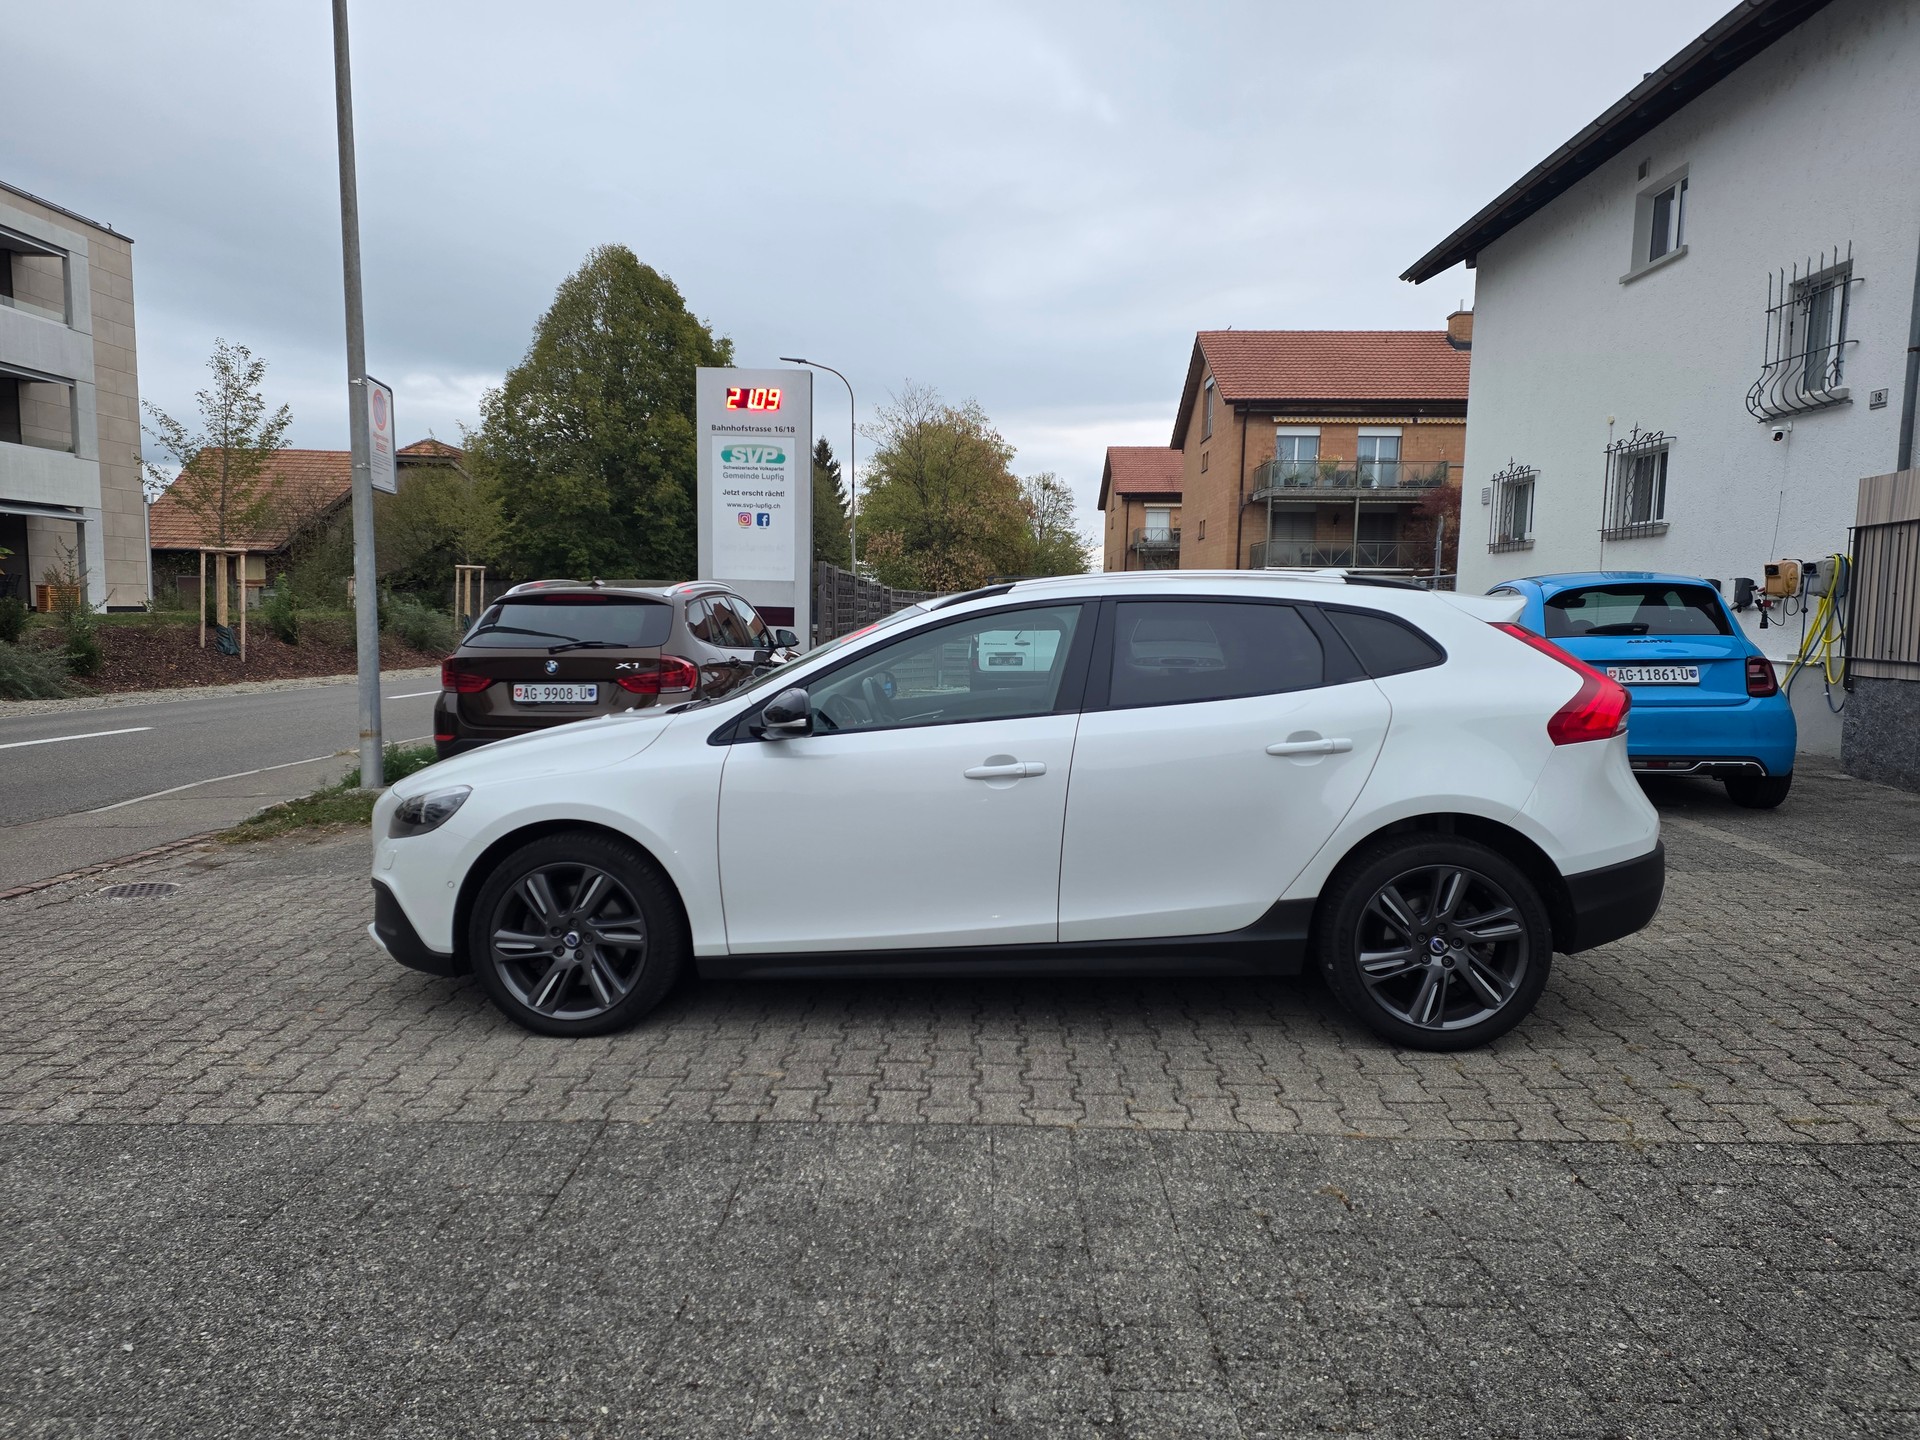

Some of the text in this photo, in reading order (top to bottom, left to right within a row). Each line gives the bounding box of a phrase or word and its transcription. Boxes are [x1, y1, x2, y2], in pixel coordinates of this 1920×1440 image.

[1875, 392, 1883, 402] 18
[711, 424, 796, 433] Bahnhofstrasse 16/18
[730, 446, 779, 464] SVP
[722, 471, 785, 482] Gemeinde Lupfig
[741, 489, 764, 497] erscht
[726, 502, 781, 510] www.svp-lupfig.ch
[615, 662, 640, 670] X1
